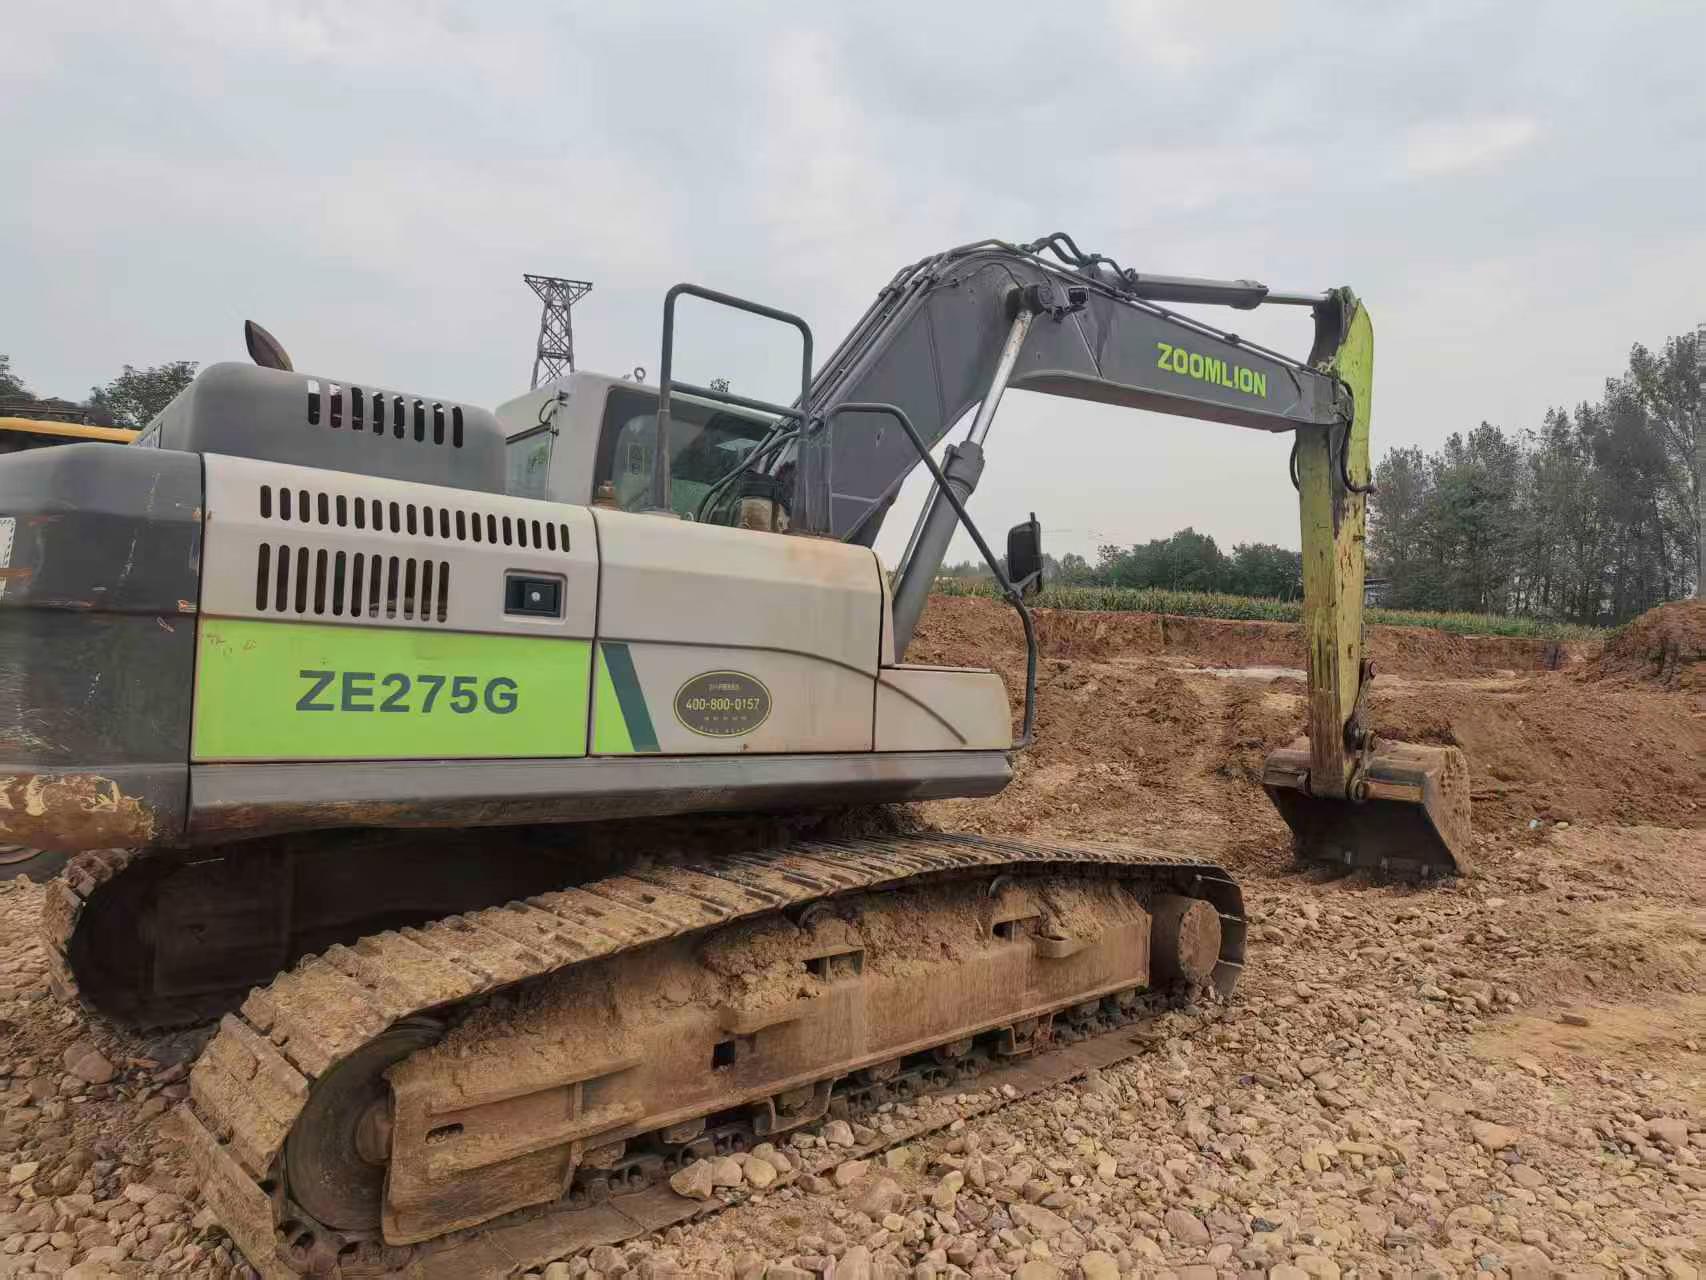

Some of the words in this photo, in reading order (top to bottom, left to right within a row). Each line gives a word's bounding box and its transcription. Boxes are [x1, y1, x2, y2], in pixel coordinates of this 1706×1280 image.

[1156, 342, 1268, 398] ZOOMLION
[295, 669, 518, 714] ZE275G
[686, 698, 760, 711] 400-800-0157
